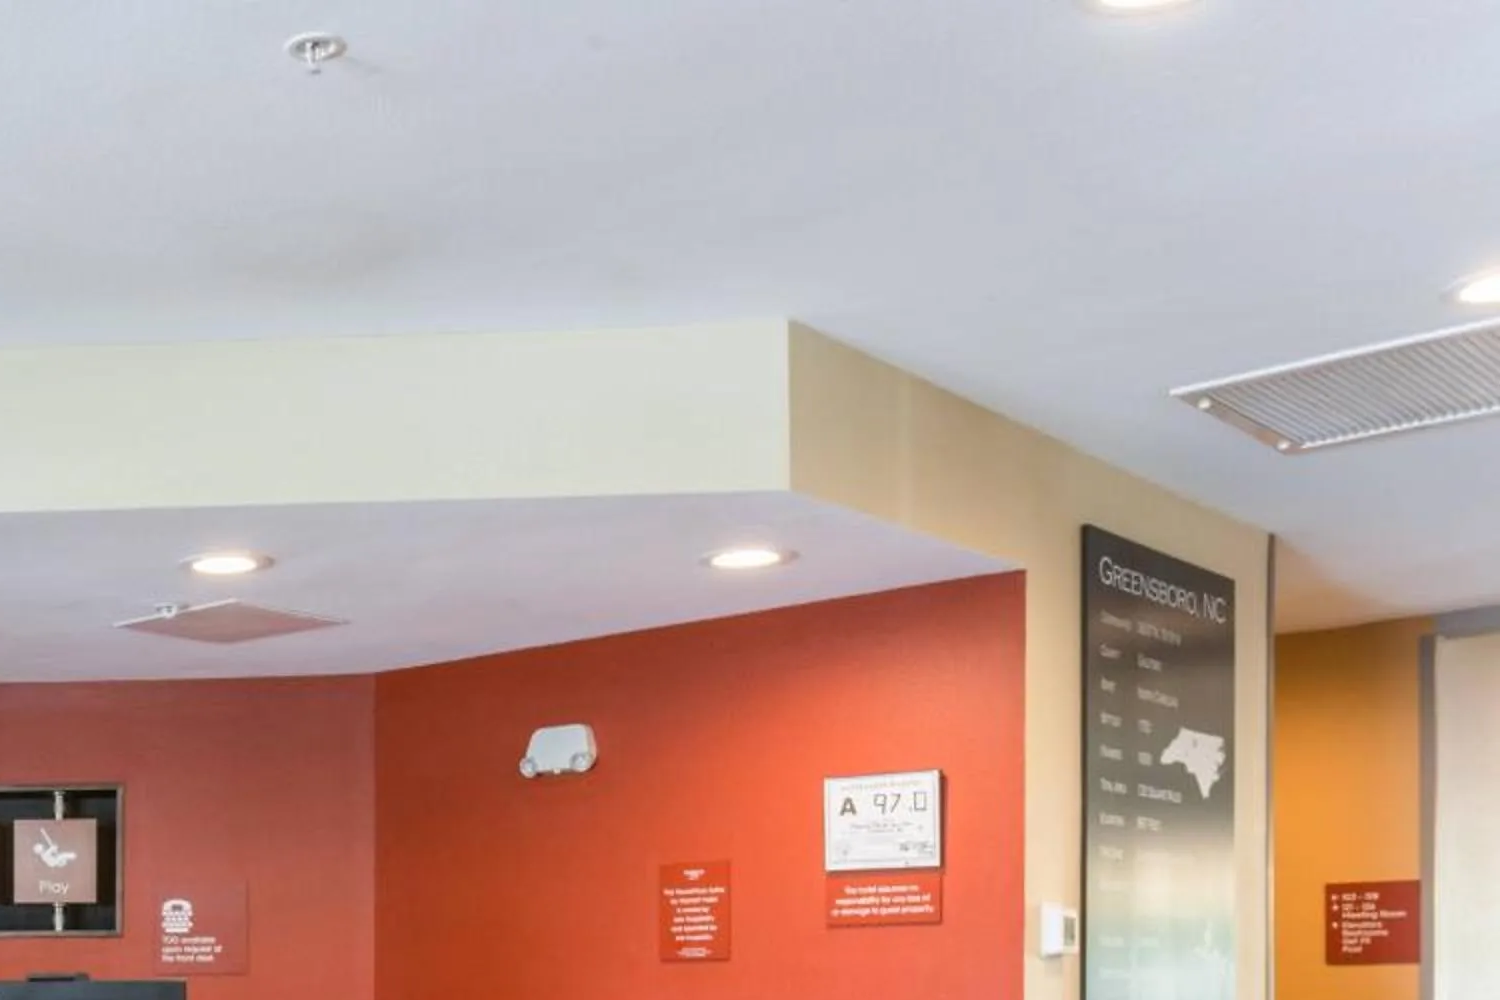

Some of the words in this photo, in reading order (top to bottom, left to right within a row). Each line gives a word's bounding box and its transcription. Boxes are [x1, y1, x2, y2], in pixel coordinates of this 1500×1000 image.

[1203, 592, 1227, 624] NC
[840, 797, 857, 816] A
[39, 880, 69, 894] Play
